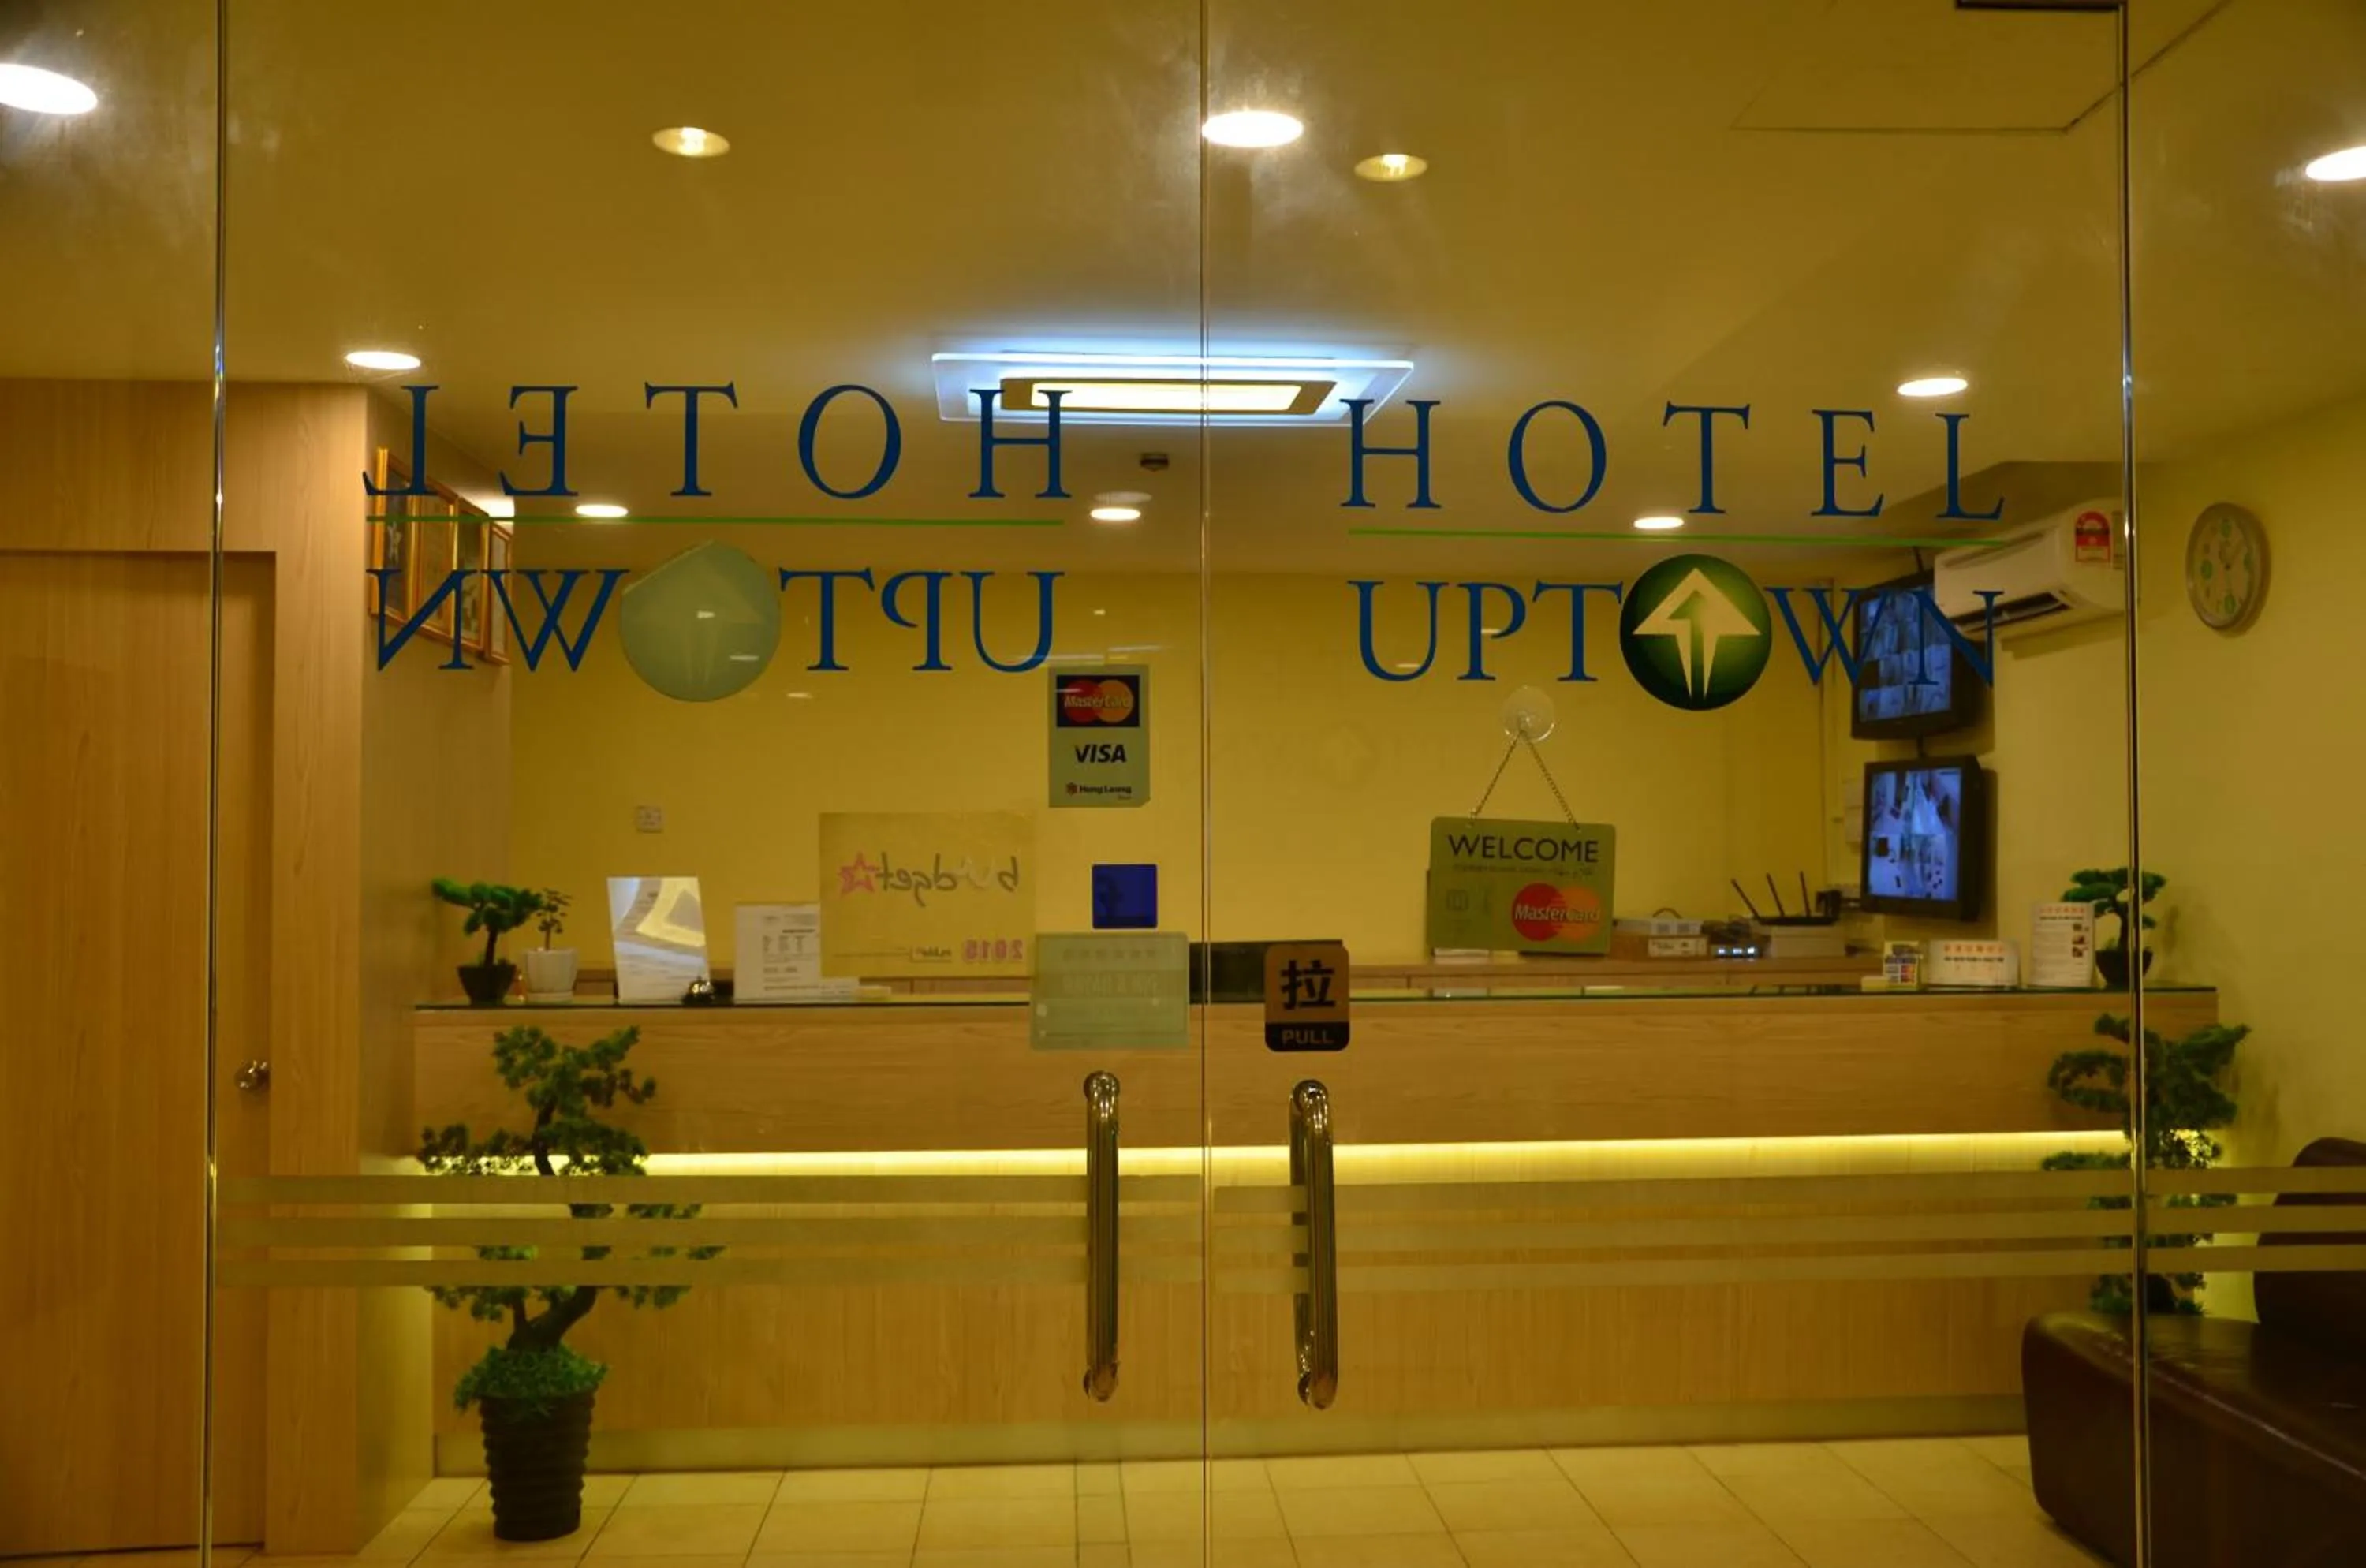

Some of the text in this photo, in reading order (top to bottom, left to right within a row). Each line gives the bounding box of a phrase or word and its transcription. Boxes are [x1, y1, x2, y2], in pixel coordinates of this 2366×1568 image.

[1339, 398, 2005, 521] HOTEL
[1075, 743, 1128, 764] VISA
[1447, 833, 1599, 864] WELCOME
[1514, 904, 1601, 922] MasterCard
[1280, 959, 1337, 1010] 拉
[1282, 1029, 1334, 1044] PULL
